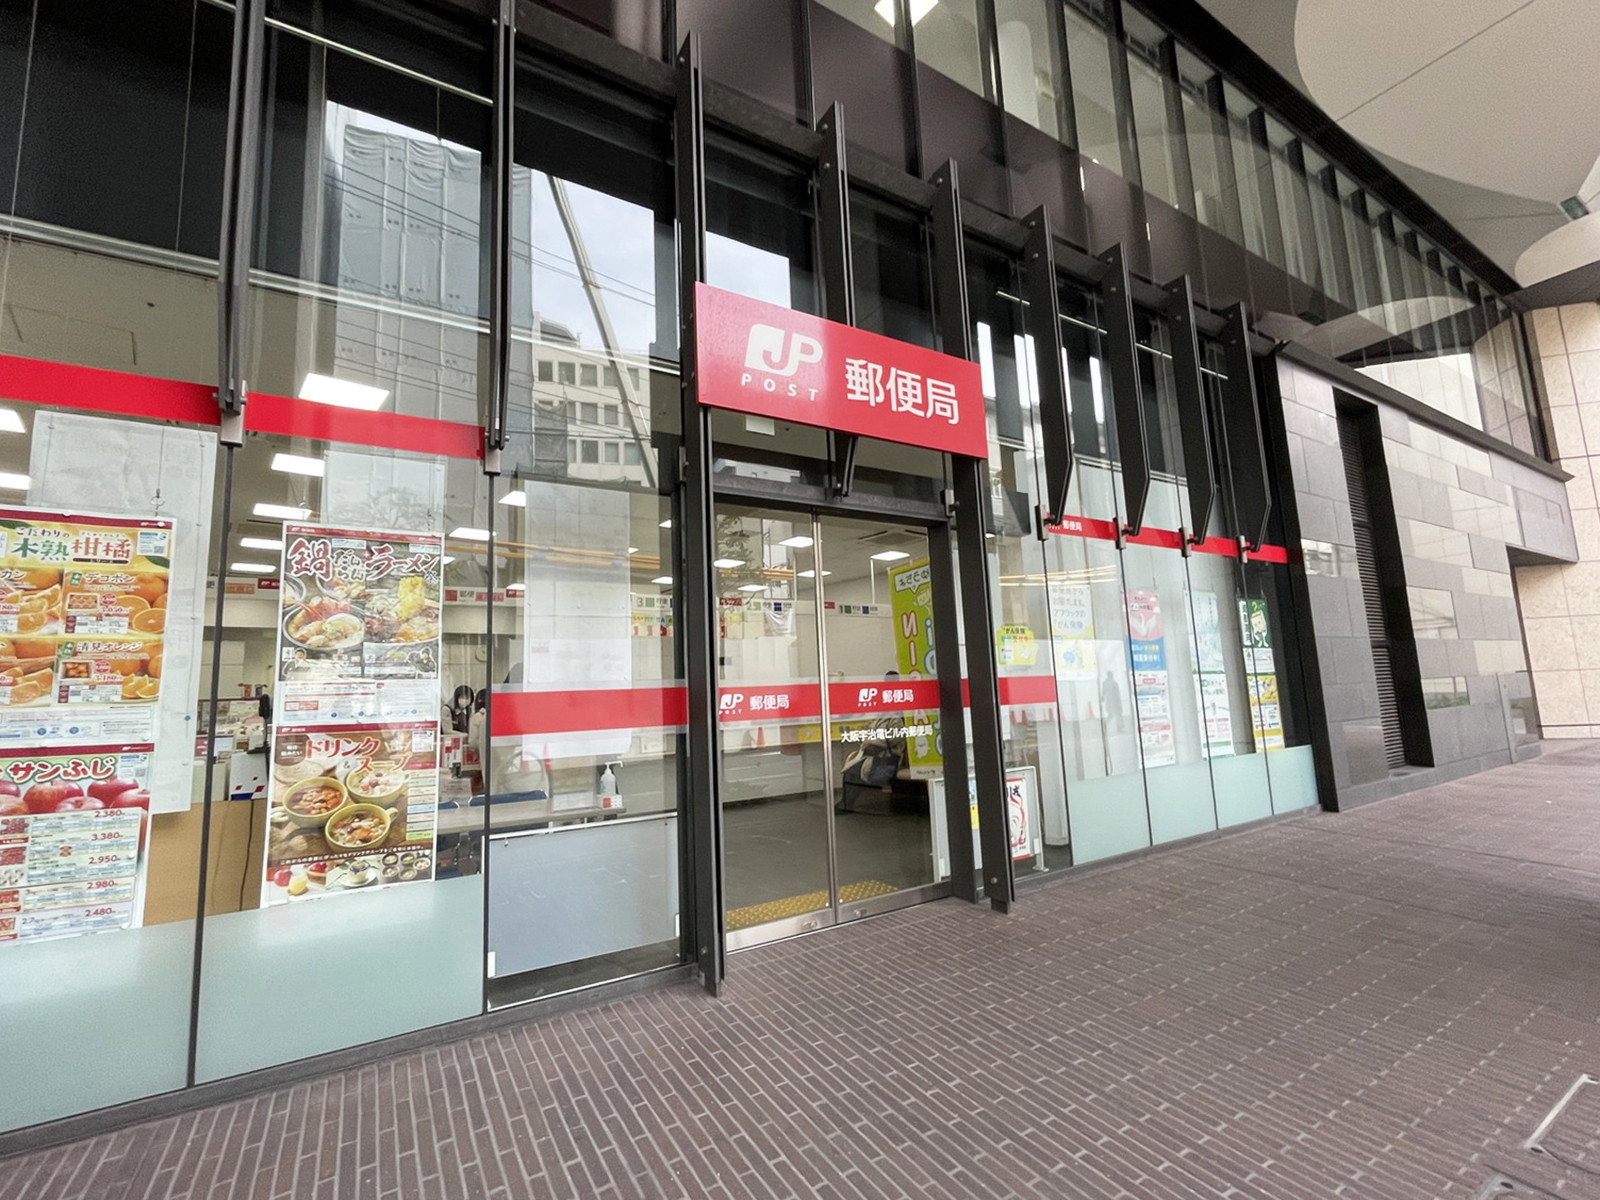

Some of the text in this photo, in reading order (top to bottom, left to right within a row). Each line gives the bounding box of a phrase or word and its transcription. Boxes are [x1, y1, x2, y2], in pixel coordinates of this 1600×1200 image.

[741, 373, 819, 402] POST
[845, 357, 960, 425] 郵便局
[13, 537, 131, 561] 木熟柑橘
[289, 539, 331, 582] 鍋
[366, 545, 440, 581] ラーメン
[749, 694, 790, 711] 郵便局
[882, 689, 914, 704] 郵便局
[841, 724, 934, 743] 大阪宇治電ビル内郵便局
[306, 737, 380, 760] ドリンク
[8, 756, 116, 784] サンふじ
[355, 752, 413, 773] スープ
